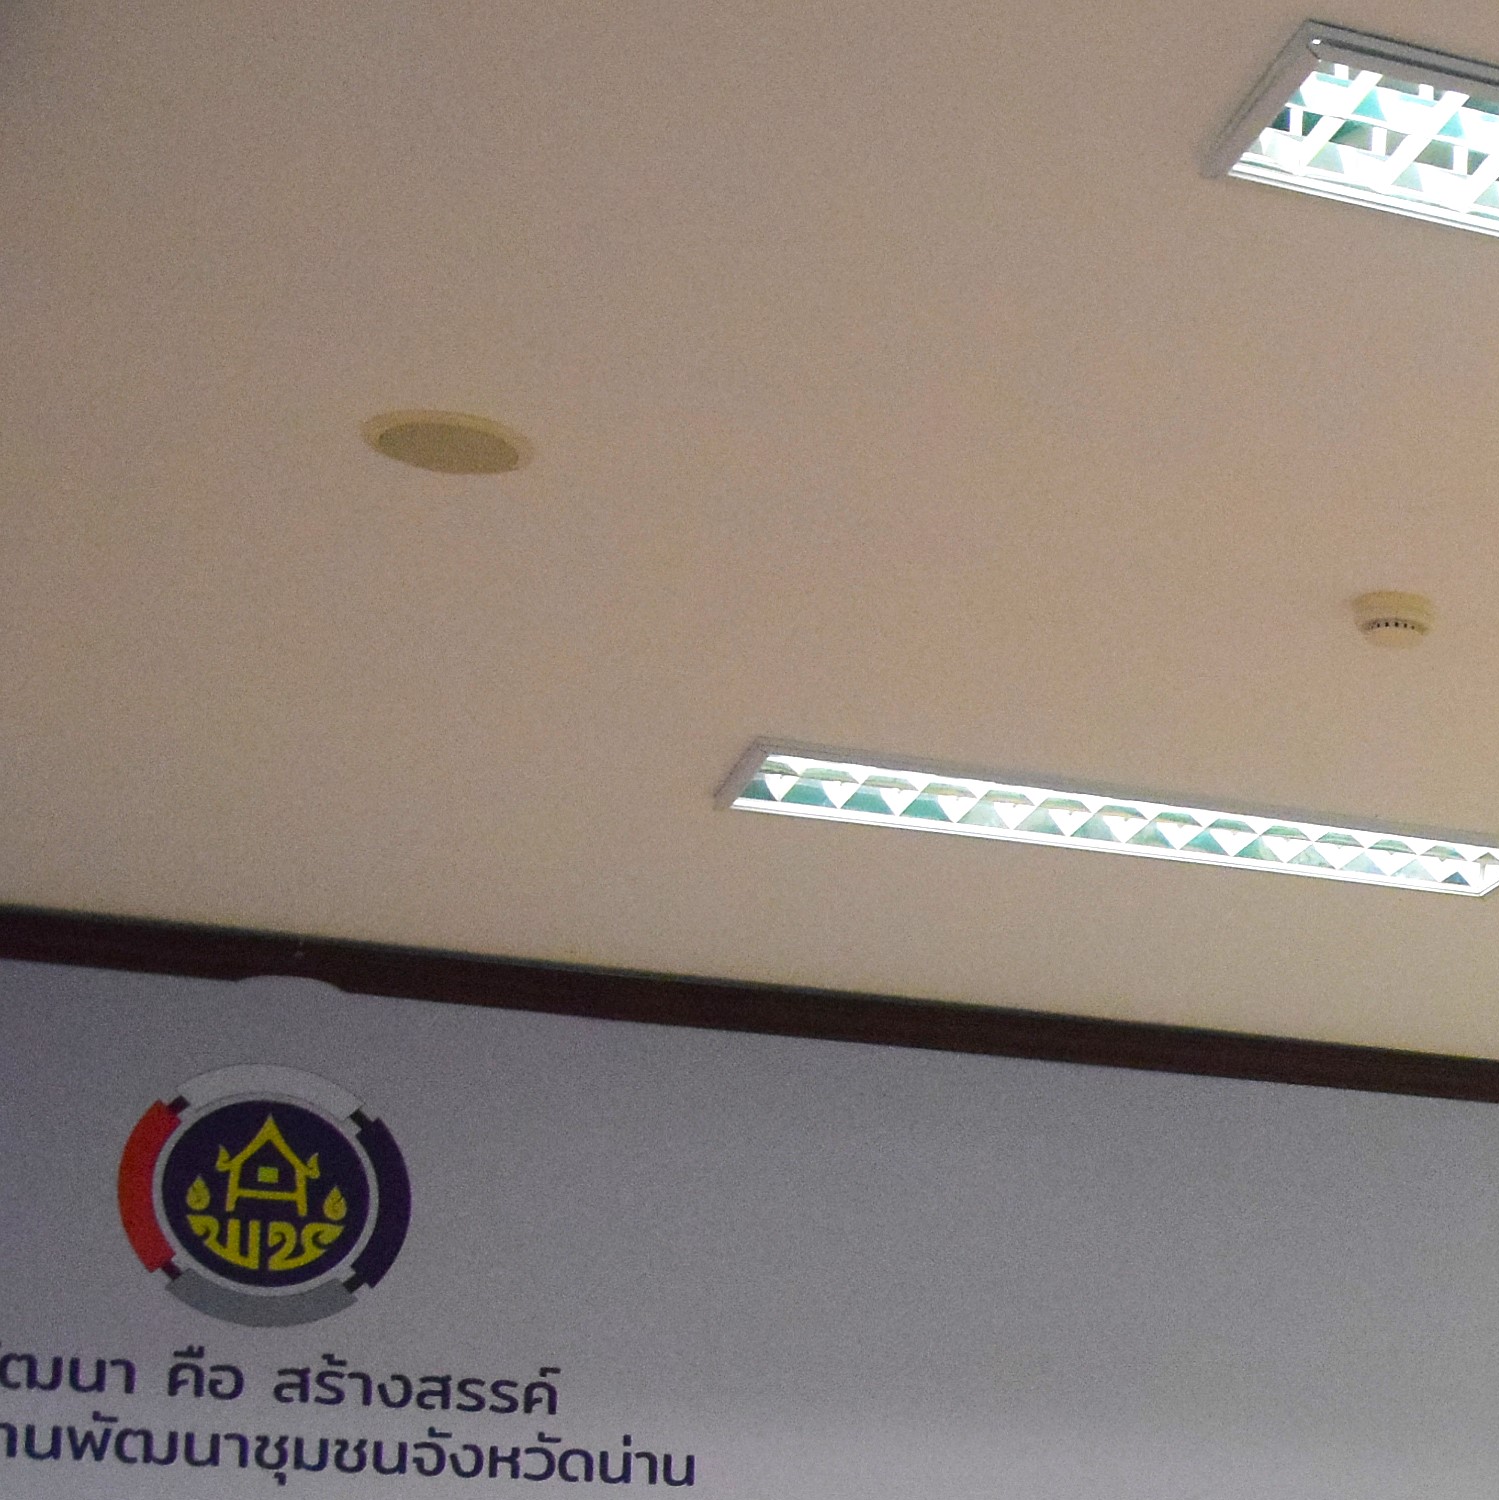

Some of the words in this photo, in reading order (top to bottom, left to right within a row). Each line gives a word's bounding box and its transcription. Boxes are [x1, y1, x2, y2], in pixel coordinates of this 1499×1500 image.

[0, 1352, 136, 1394] ฒนา
[167, 1345, 245, 1400] คือ
[273, 1353, 561, 1415] สร้างสรรค์
